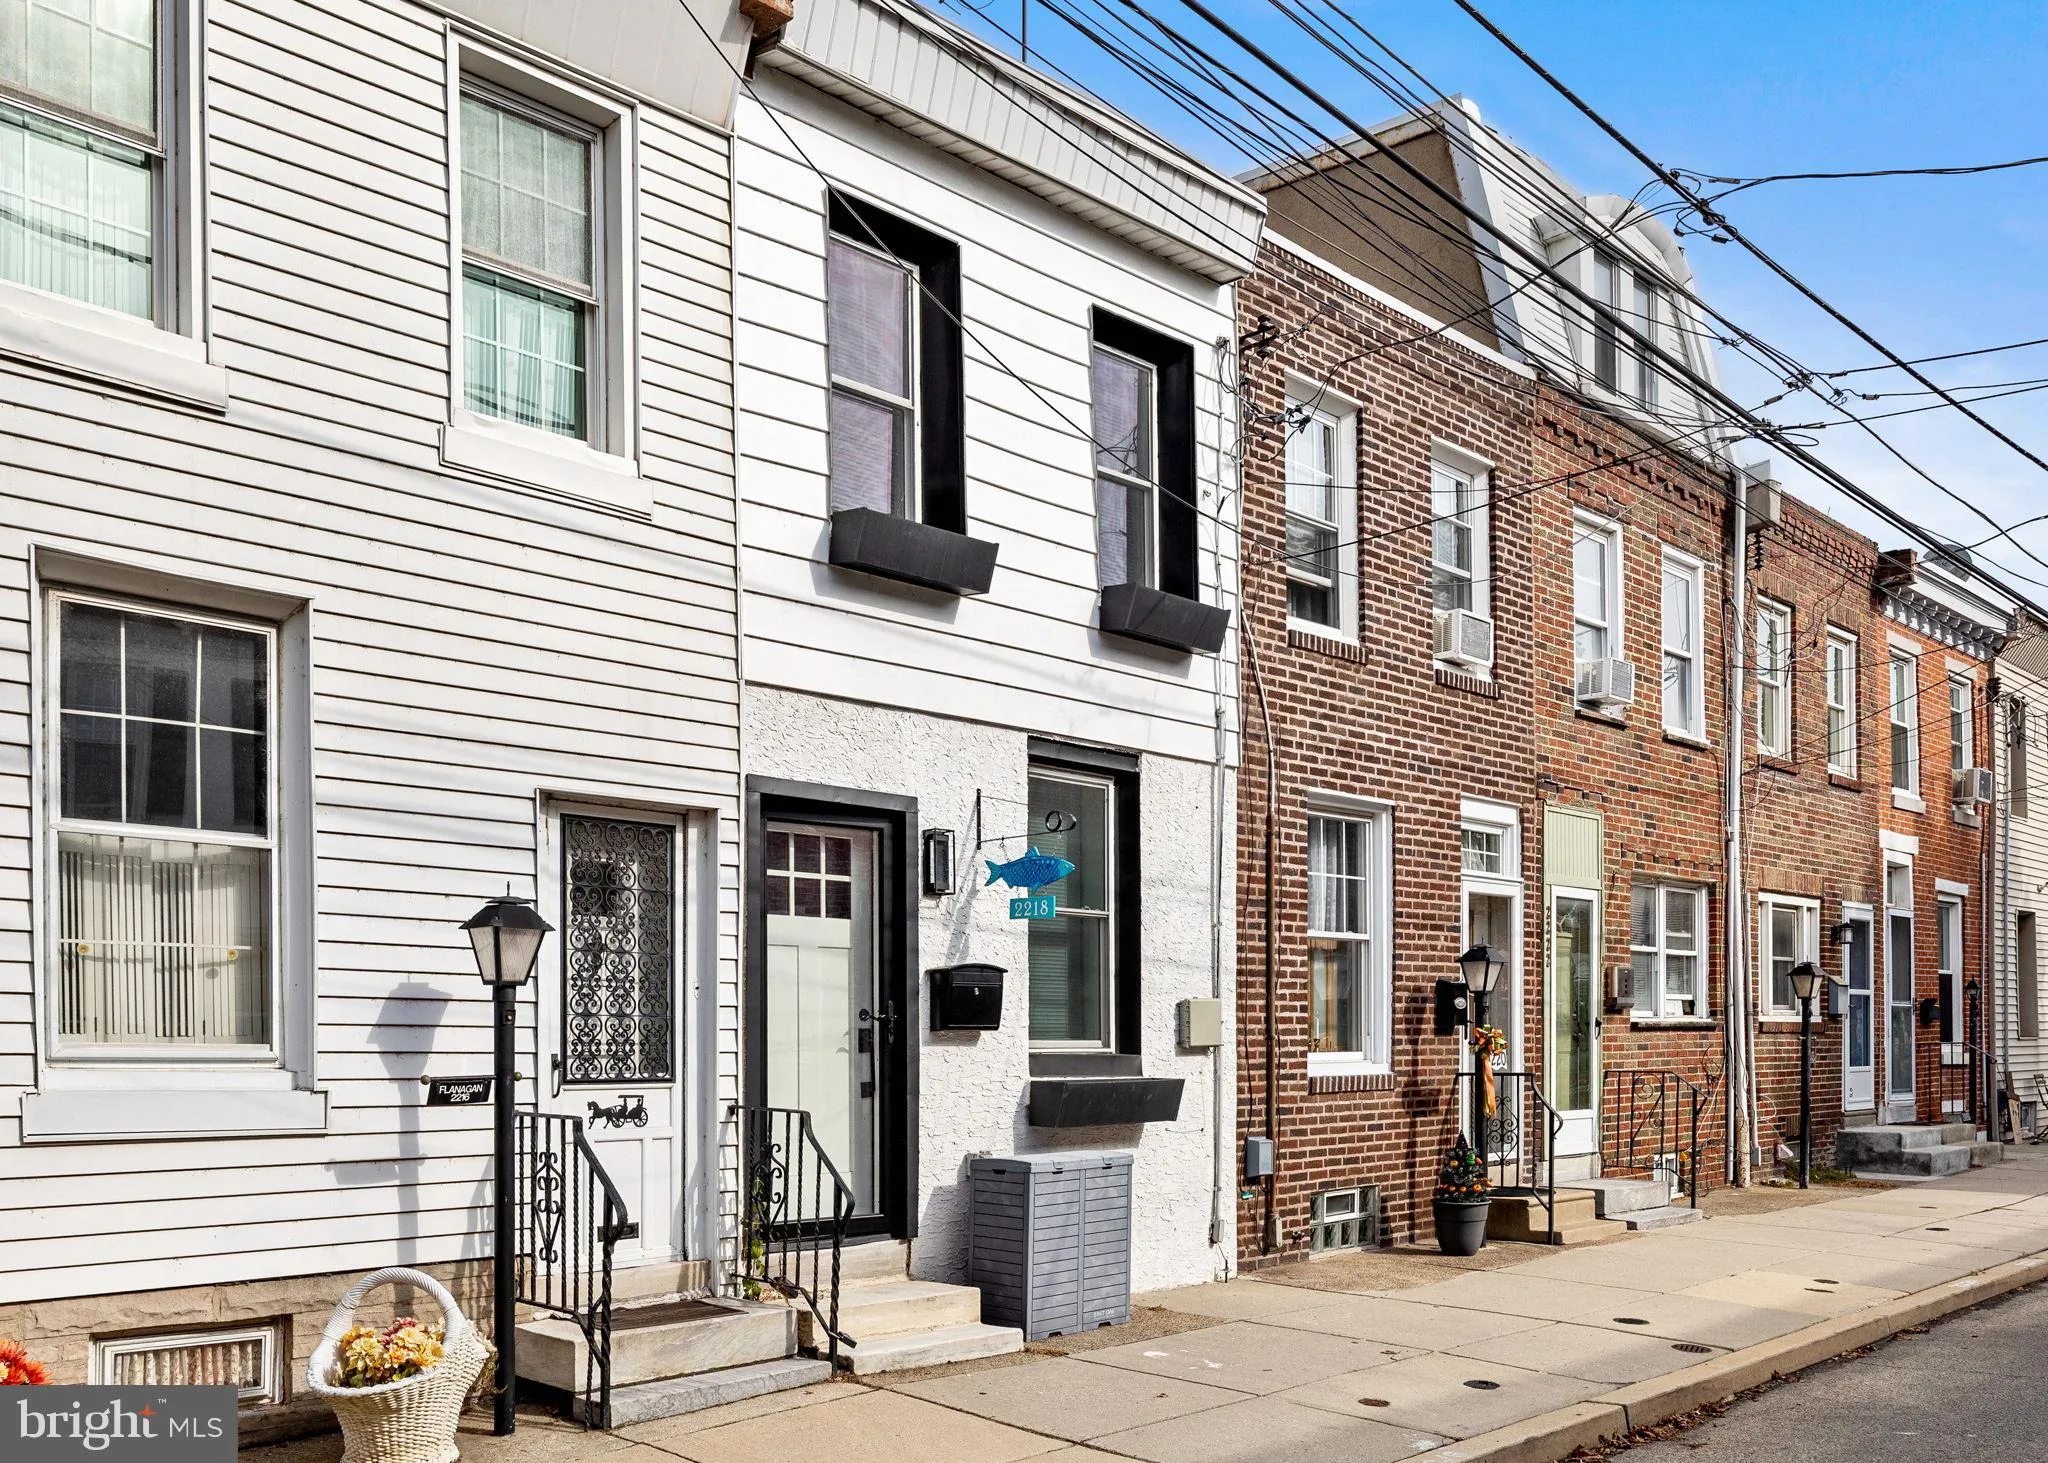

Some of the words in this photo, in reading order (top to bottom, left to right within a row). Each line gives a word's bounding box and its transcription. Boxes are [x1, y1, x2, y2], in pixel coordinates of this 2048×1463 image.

[1015, 899, 1049, 917] 2218
[438, 1084, 484, 1095] FLANAGAN
[450, 1093, 471, 1103] 2216
